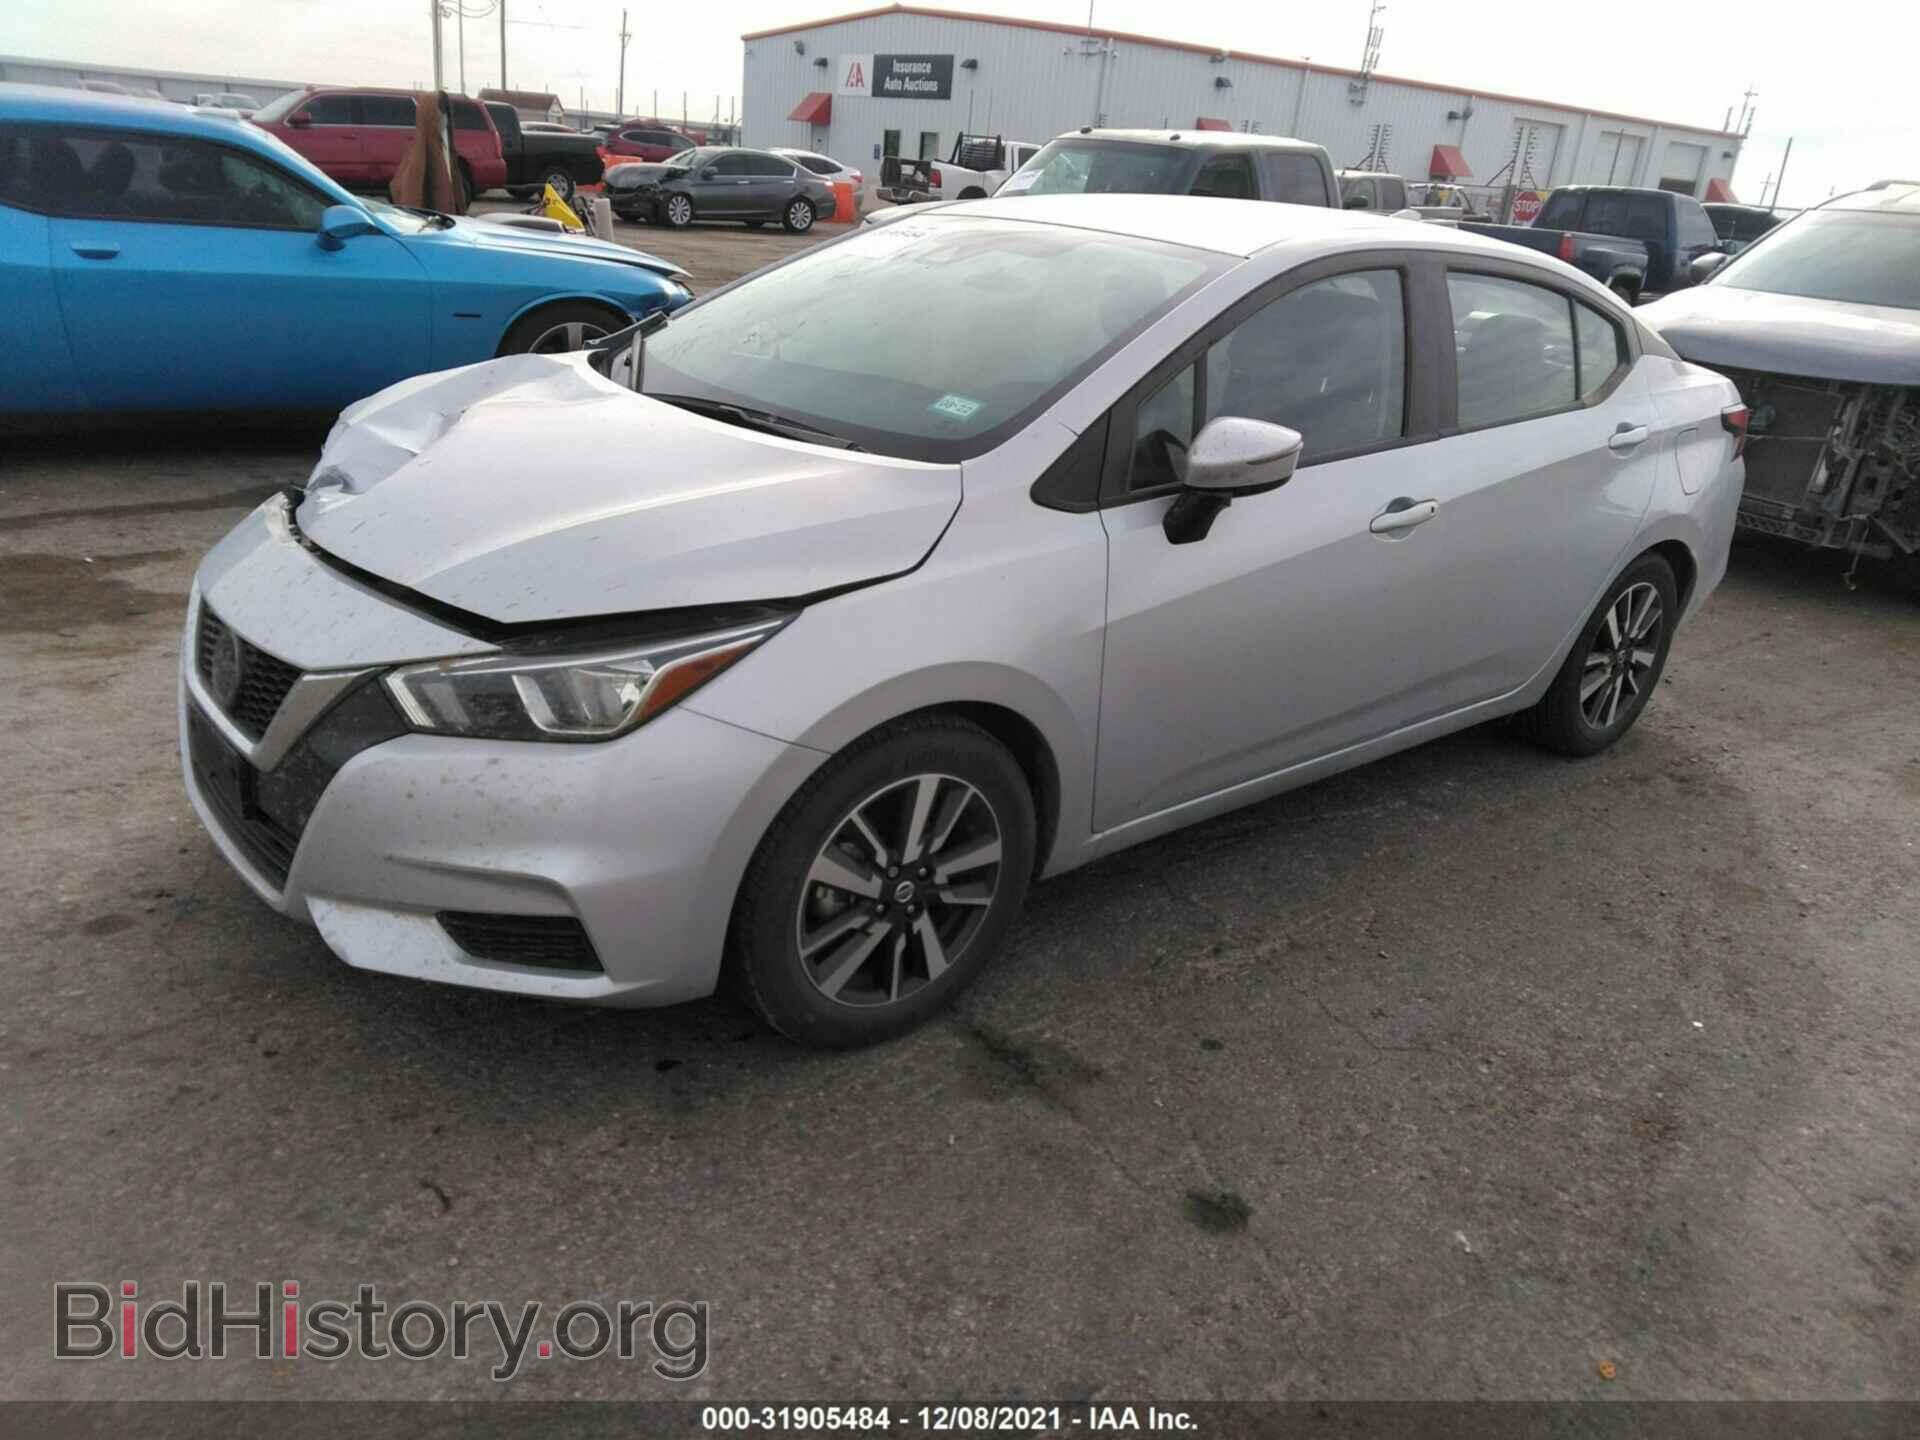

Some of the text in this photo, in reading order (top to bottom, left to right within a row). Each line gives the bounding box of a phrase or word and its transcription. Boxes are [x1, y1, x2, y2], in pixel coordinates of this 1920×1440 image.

[892, 60, 932, 73] Insurance
[884, 76, 938, 92] Auto Auctions
[1515, 199, 1540, 212] STOP
